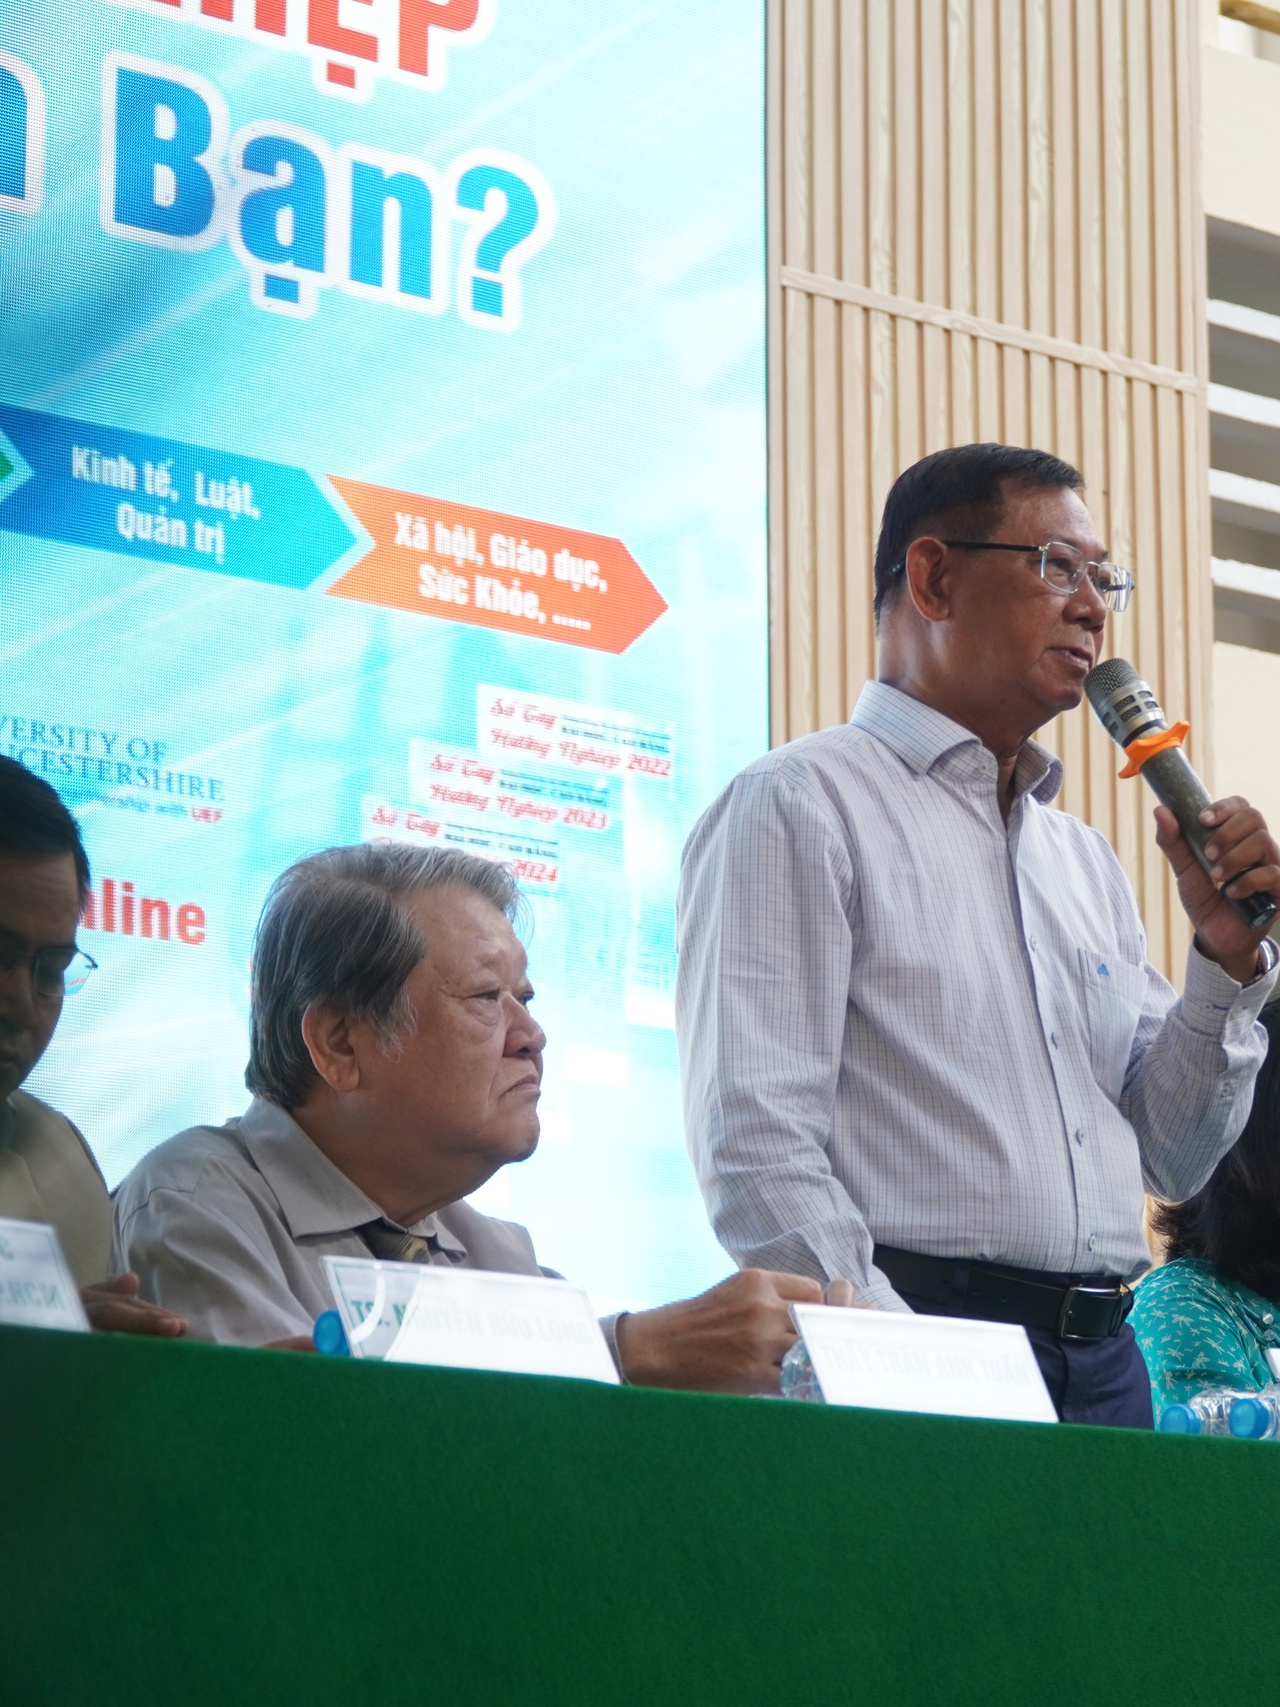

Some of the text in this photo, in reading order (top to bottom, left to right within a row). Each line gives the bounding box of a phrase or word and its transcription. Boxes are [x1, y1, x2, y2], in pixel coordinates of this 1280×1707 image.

[113, 65, 540, 318] Bạn?
[72, 445, 262, 521] Kinh tế, Luật,
[116, 502, 226, 564] Quản trị
[395, 512, 608, 594] Xã hội, Giáo dục,
[418, 563, 469, 606] Sức
[127, 736, 167, 765] OF
[627, 753, 672, 778] 2022
